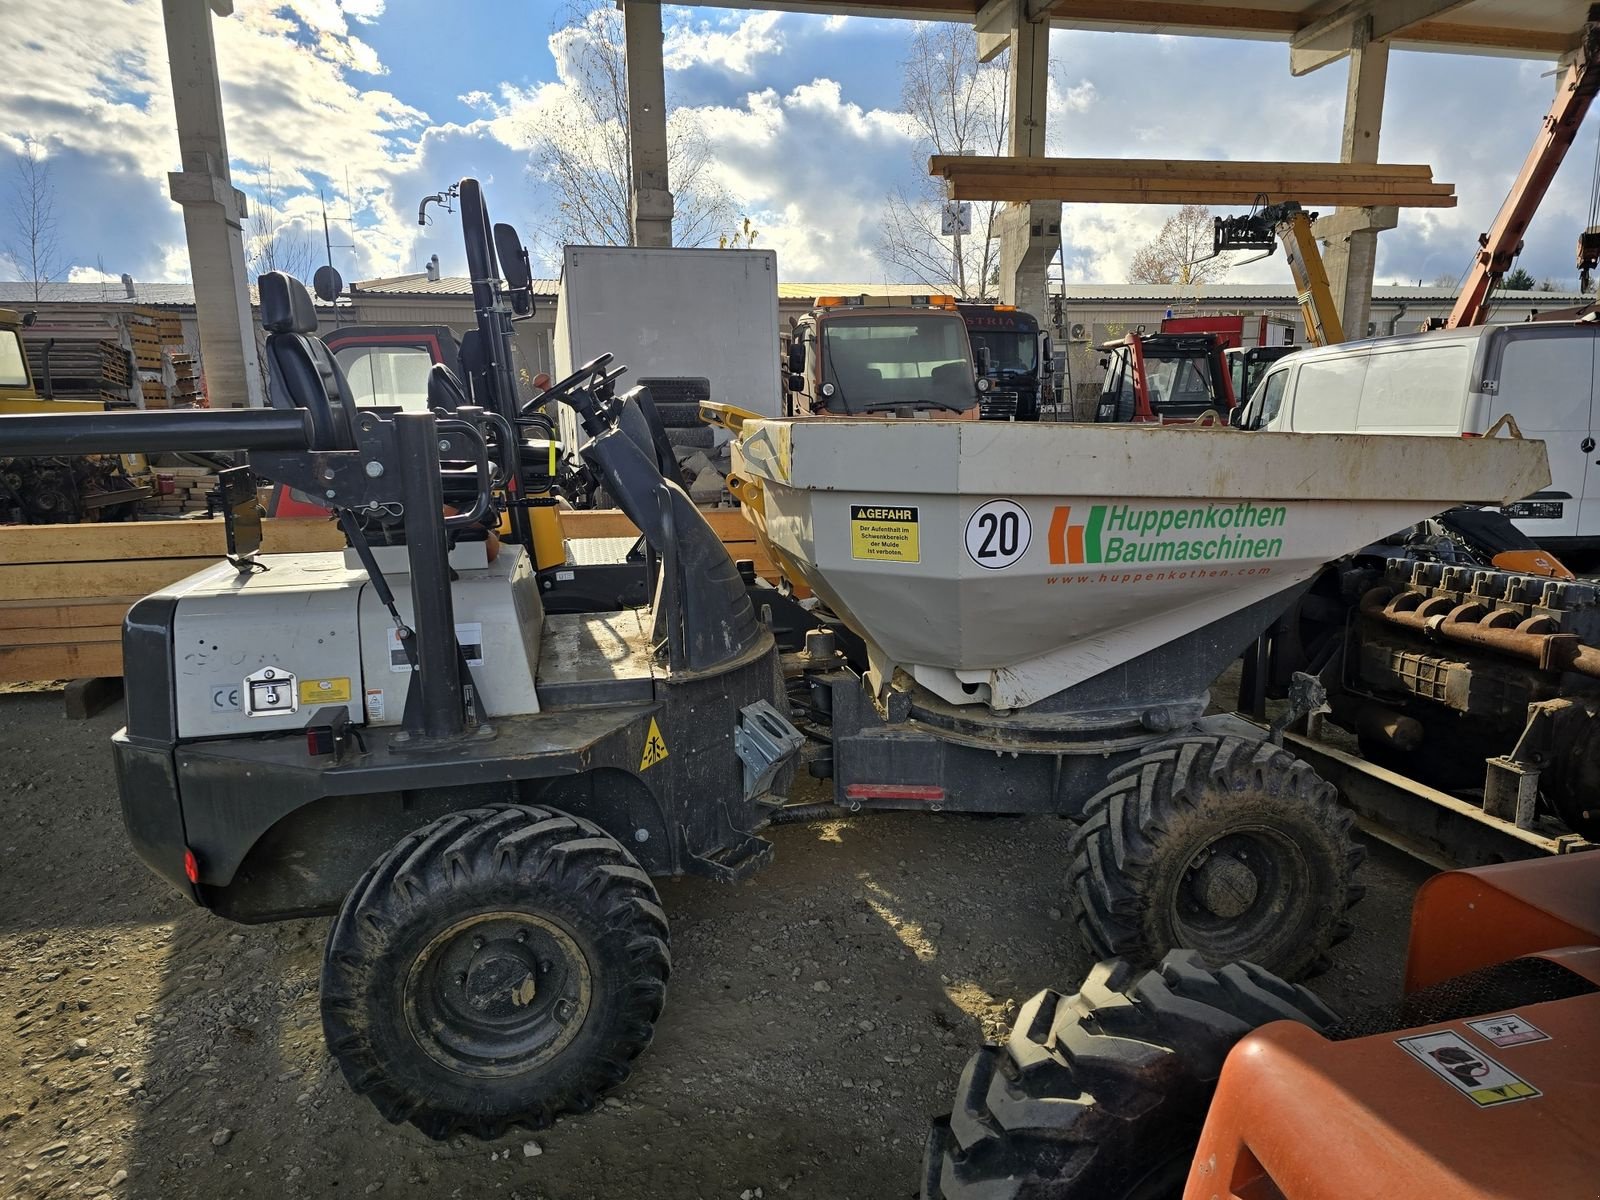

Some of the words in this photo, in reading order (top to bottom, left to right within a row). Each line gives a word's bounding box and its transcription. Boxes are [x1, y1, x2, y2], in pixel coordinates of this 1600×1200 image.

[966, 317, 1014, 326] STRIA
[866, 508, 912, 520] GEFAHR
[1107, 502, 1287, 537] Huppenkothen
[861, 533, 909, 541] Schwenkbereich
[977, 511, 1019, 558] 20
[1104, 533, 1283, 563] Baumaschinen
[1047, 566, 1271, 585] www.huppenkothen.com
